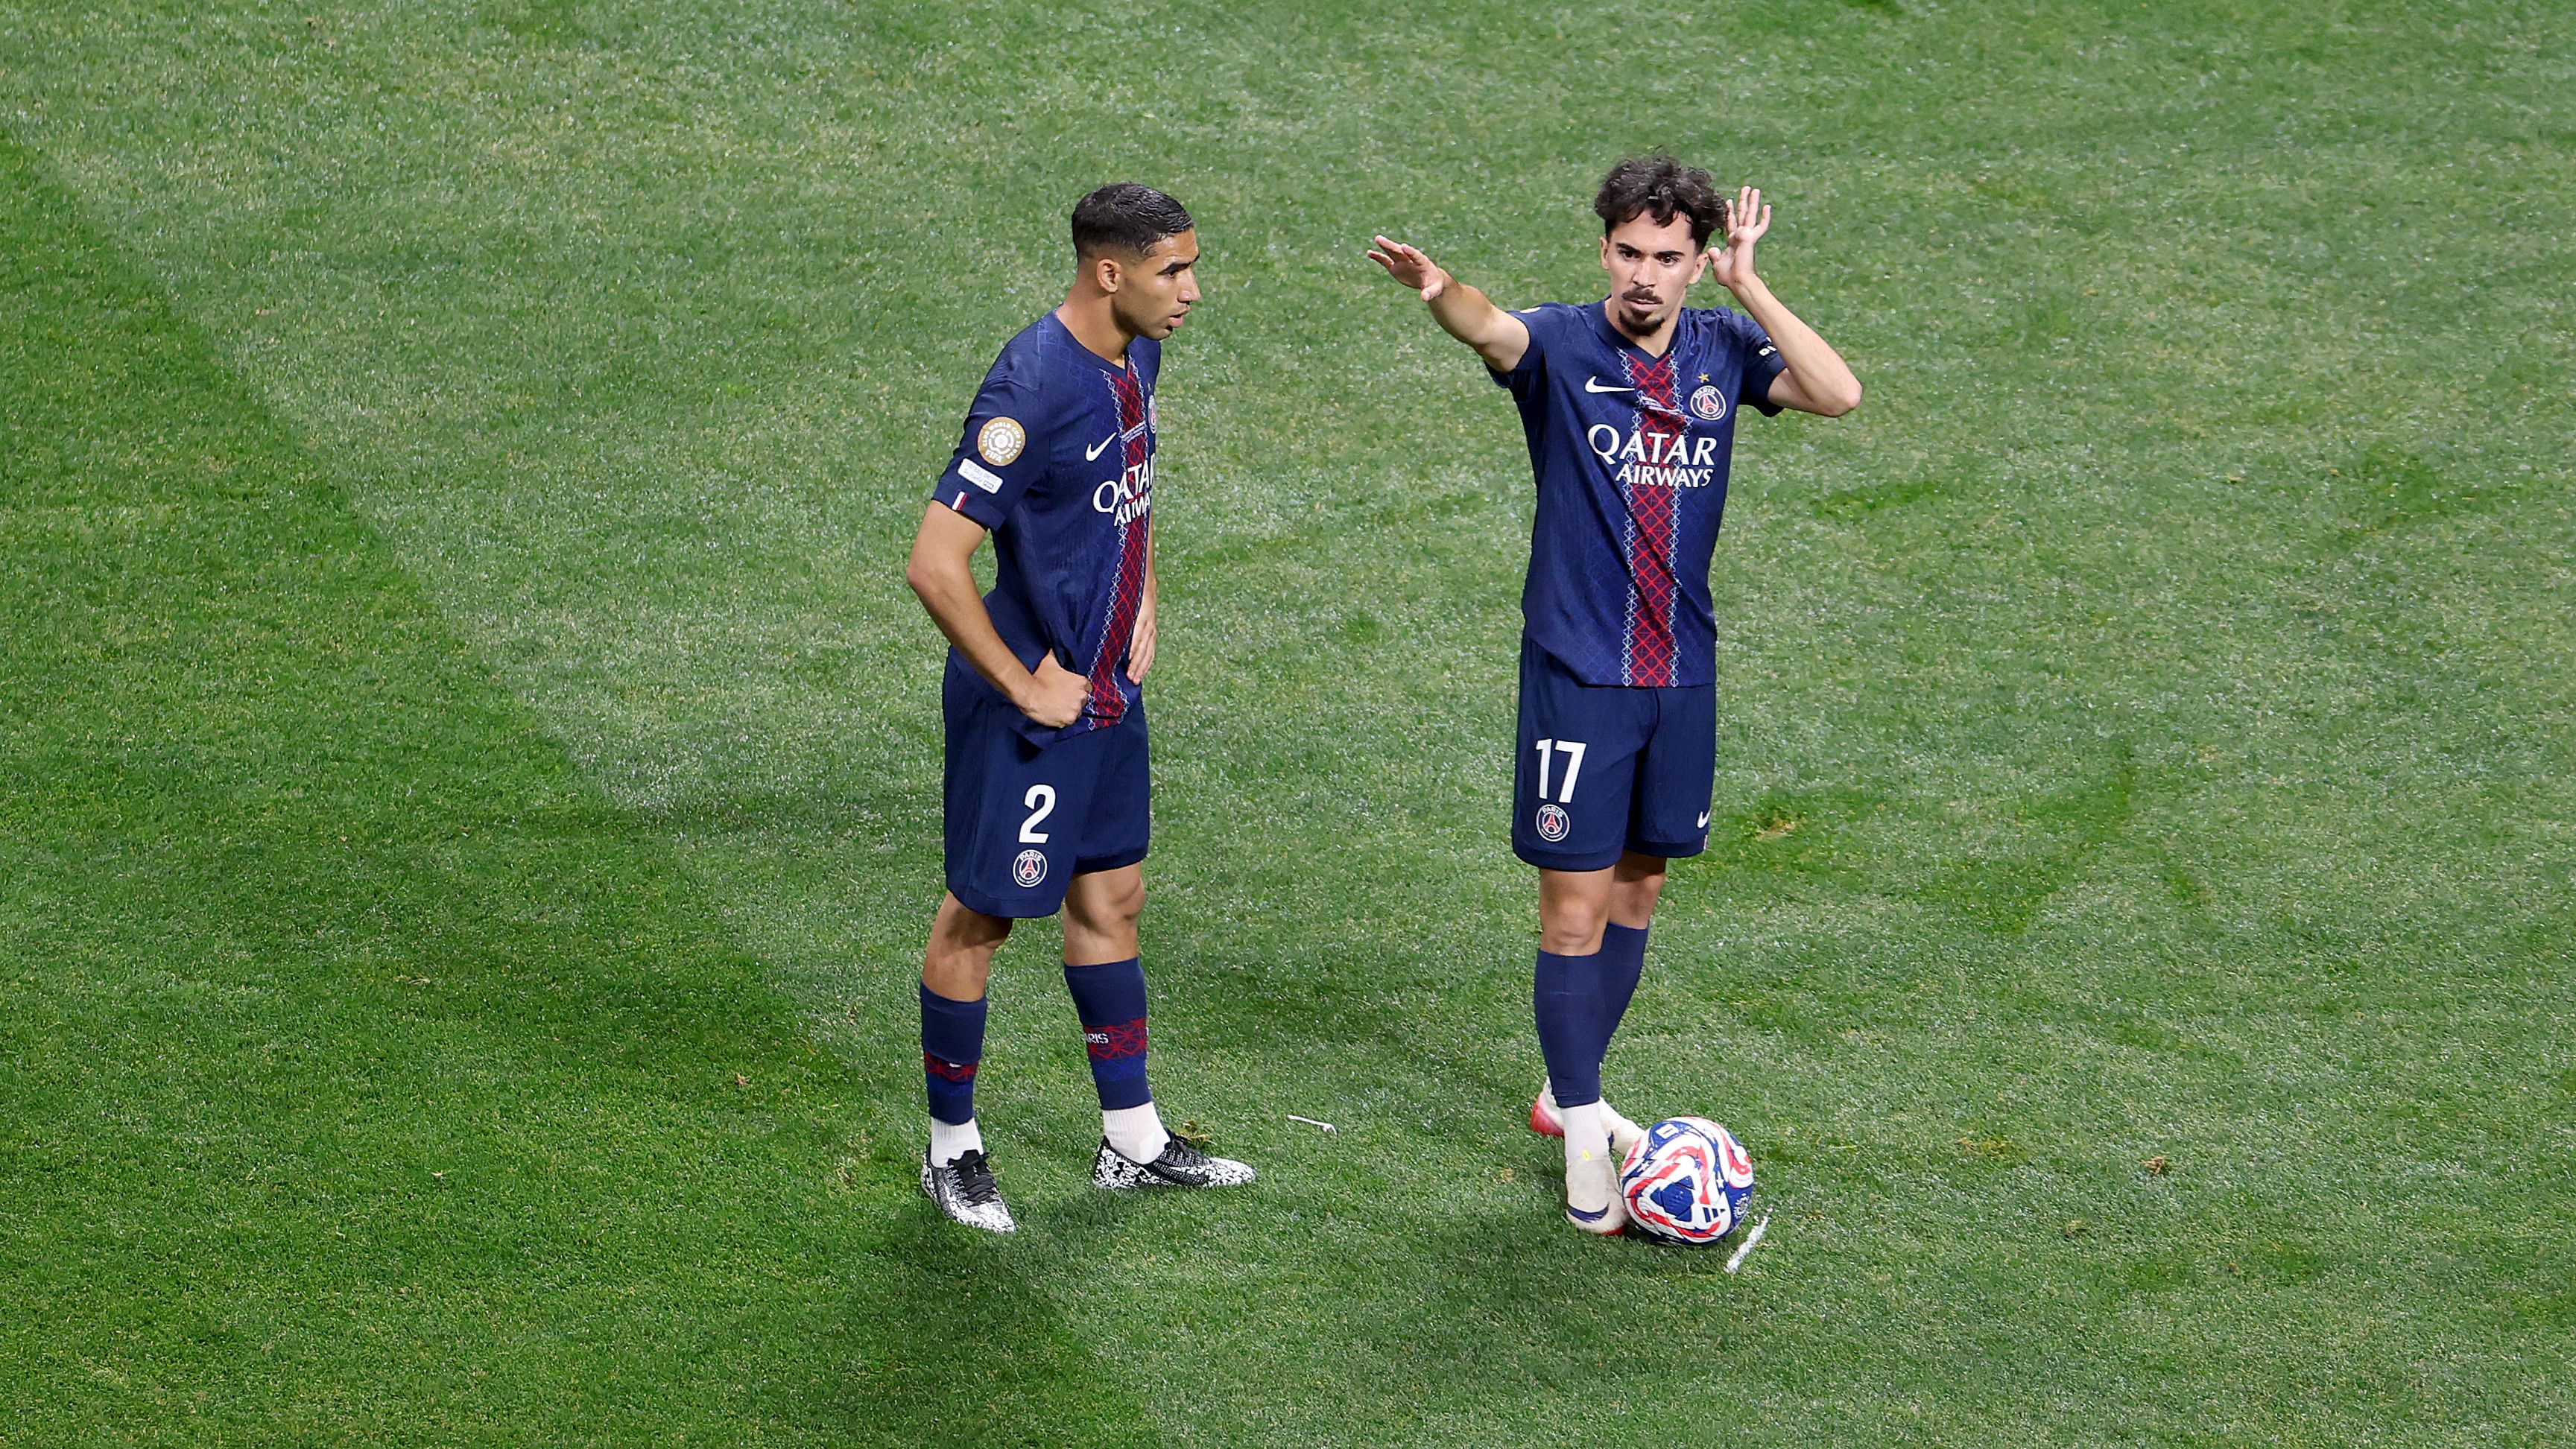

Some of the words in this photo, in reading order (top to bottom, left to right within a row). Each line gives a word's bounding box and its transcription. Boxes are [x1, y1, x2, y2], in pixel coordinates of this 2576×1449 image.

[988, 422, 1011, 431] WORLD
[1588, 424, 1717, 465] QATAR
[1615, 463, 1714, 488] AIRWAYS
[1536, 738, 1586, 803] 17
[1019, 784, 1056, 843] 2
[1019, 852, 1042, 861] PARIS
[1084, 1033, 1110, 1044] ARIS
